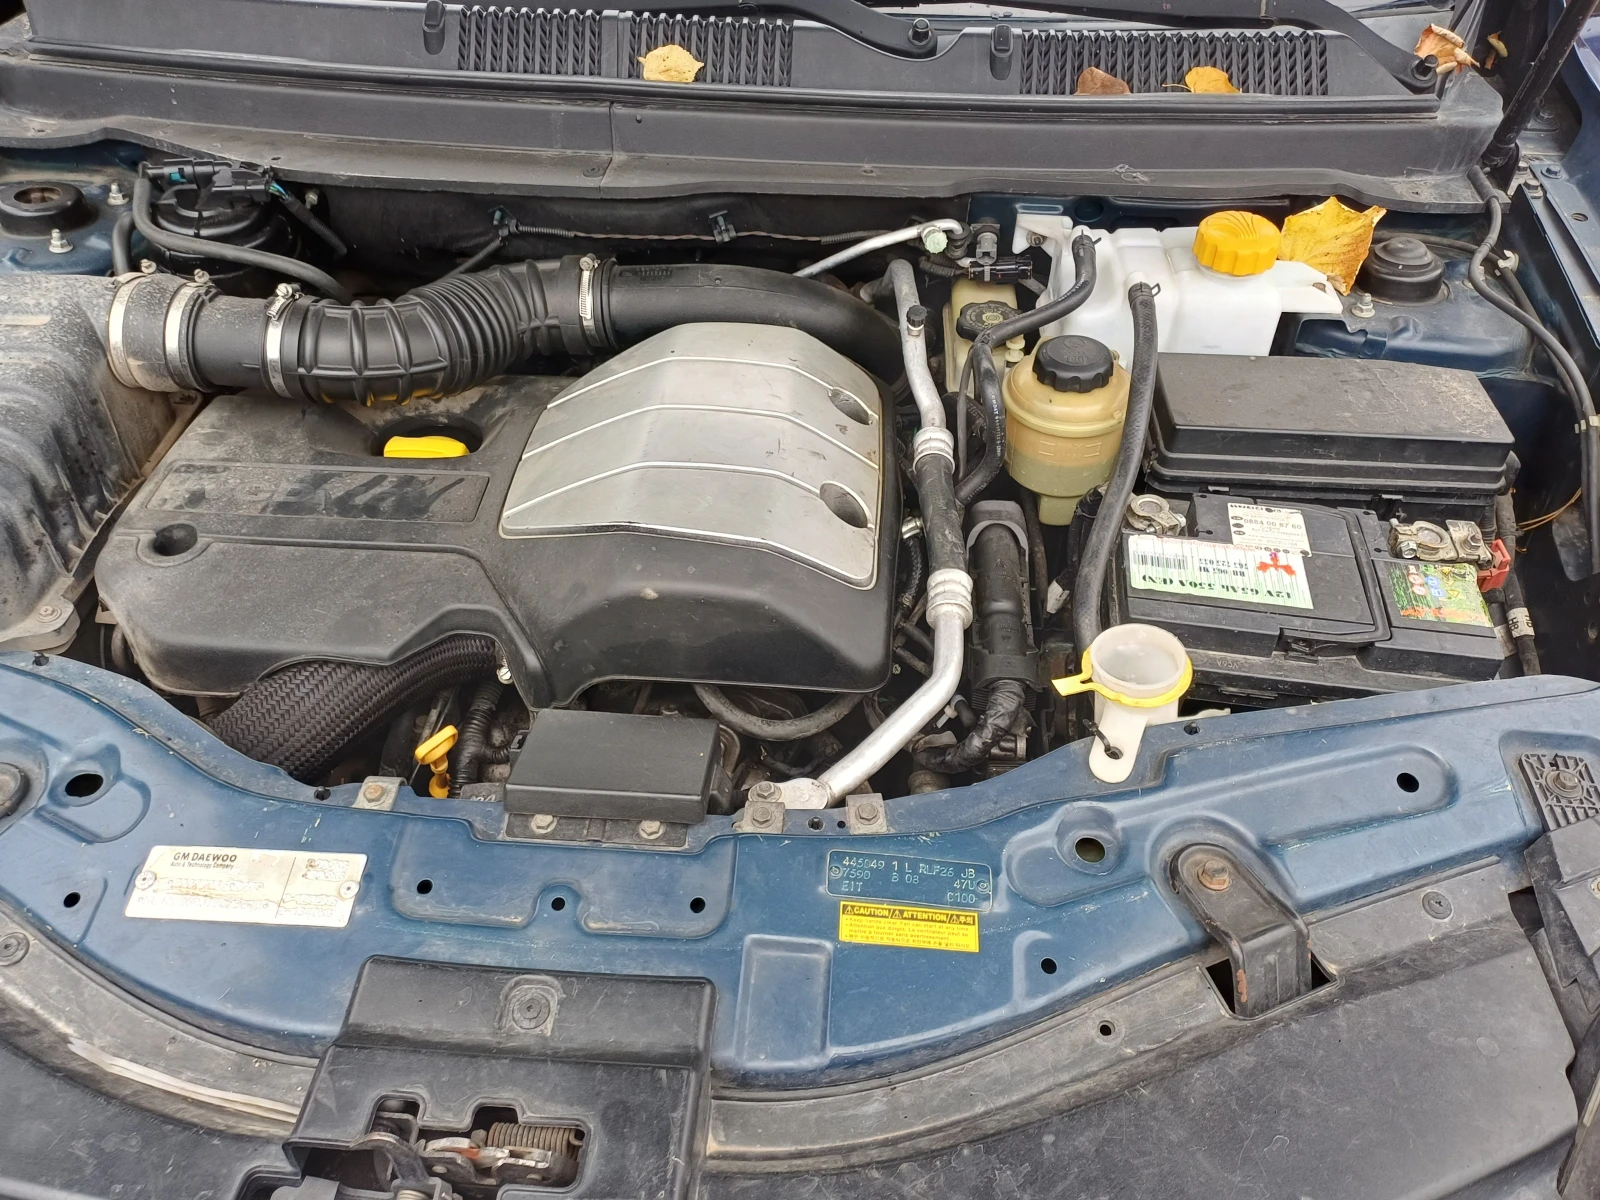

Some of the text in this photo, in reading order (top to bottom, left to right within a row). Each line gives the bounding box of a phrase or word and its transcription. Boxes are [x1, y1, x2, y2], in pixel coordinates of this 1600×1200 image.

[1178, 579, 1216, 590] 550A
[1221, 584, 1259, 595] 65Ah
[1264, 590, 1290, 599] 12V
[173, 852, 238, 862] GM DAEWOO
[187, 862, 212, 870] Technology
[212, 862, 234, 870] Company
[905, 862, 912, 872] L
[961, 868, 976, 878] JB
[854, 906, 947, 922] CAUTION ATTENTION
[960, 915, 974, 924] 주의
